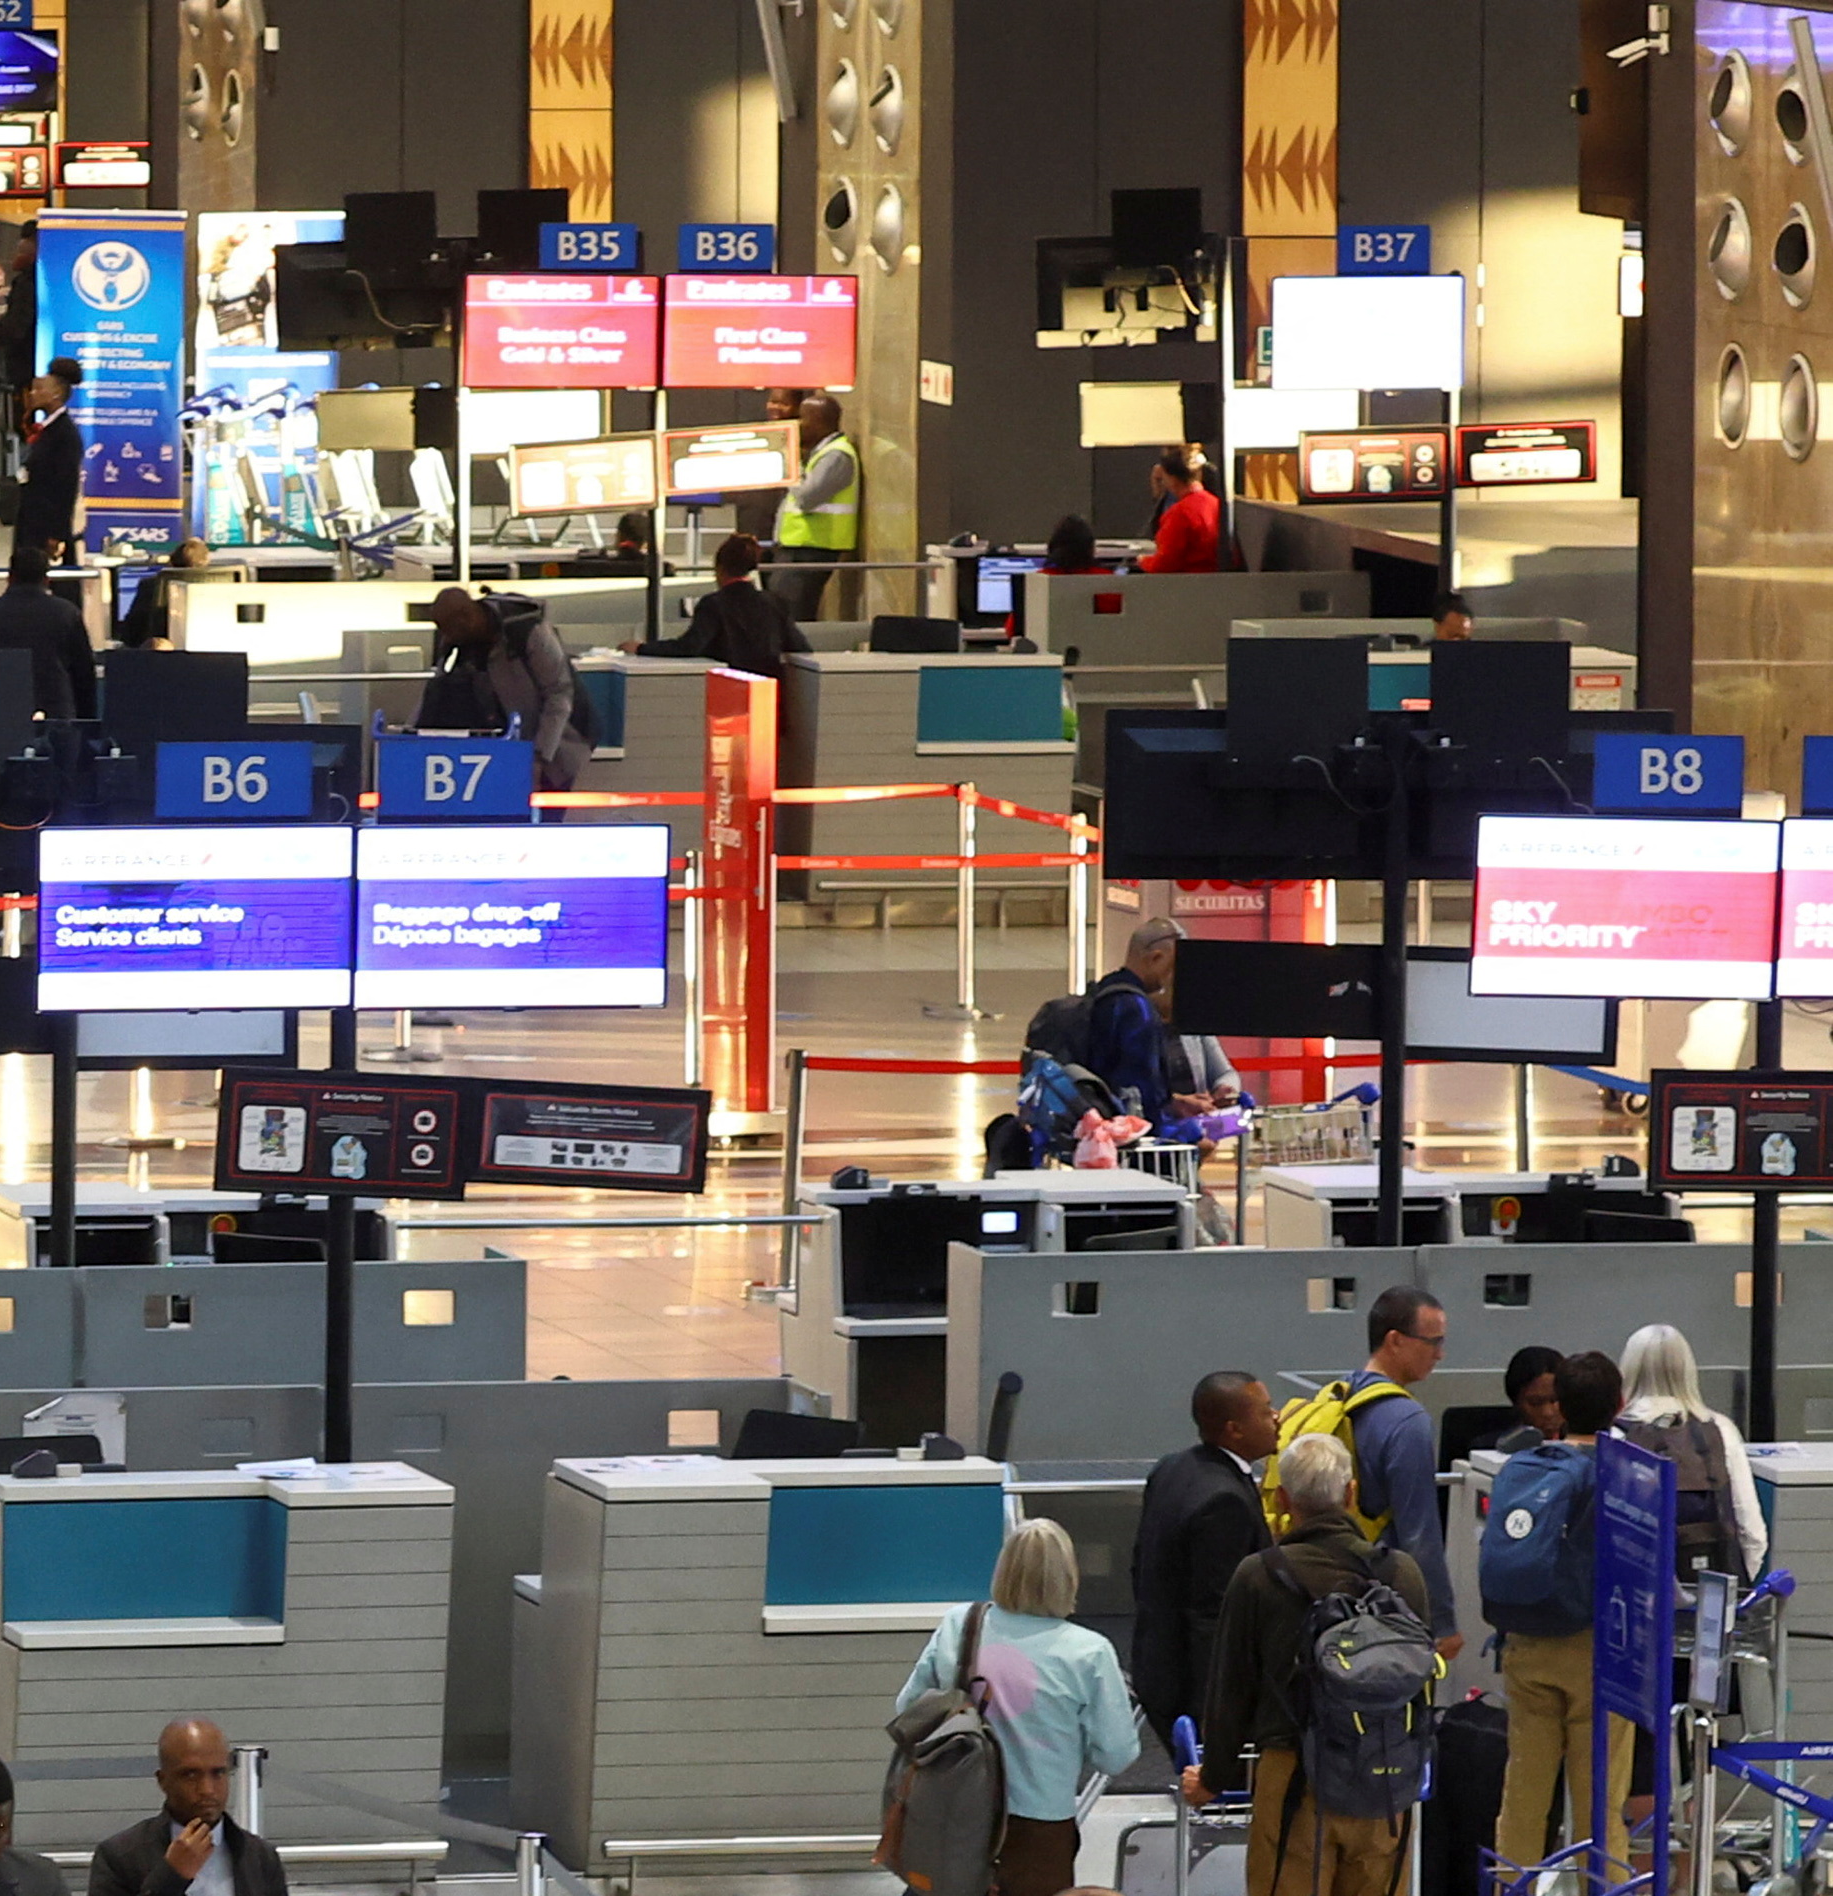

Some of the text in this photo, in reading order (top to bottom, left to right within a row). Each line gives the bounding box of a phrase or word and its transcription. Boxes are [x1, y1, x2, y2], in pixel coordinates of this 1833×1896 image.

[559, 231, 619, 260] B35
[697, 232, 758, 261] B36
[1355, 233, 1415, 262] B37
[127, 527, 170, 542] SARS
[204, 757, 267, 802] B6
[426, 755, 491, 801] B7
[1641, 749, 1702, 794] B8
[56, 904, 244, 925] Customer service
[374, 902, 561, 926] Baggage drop-off
[1173, 894, 1266, 912] SECURITAS
[1491, 901, 1557, 924] SKY
[56, 927, 201, 946] Service clients
[454, 925, 541, 947] bagages
[1490, 925, 1637, 948] PRIORITY
